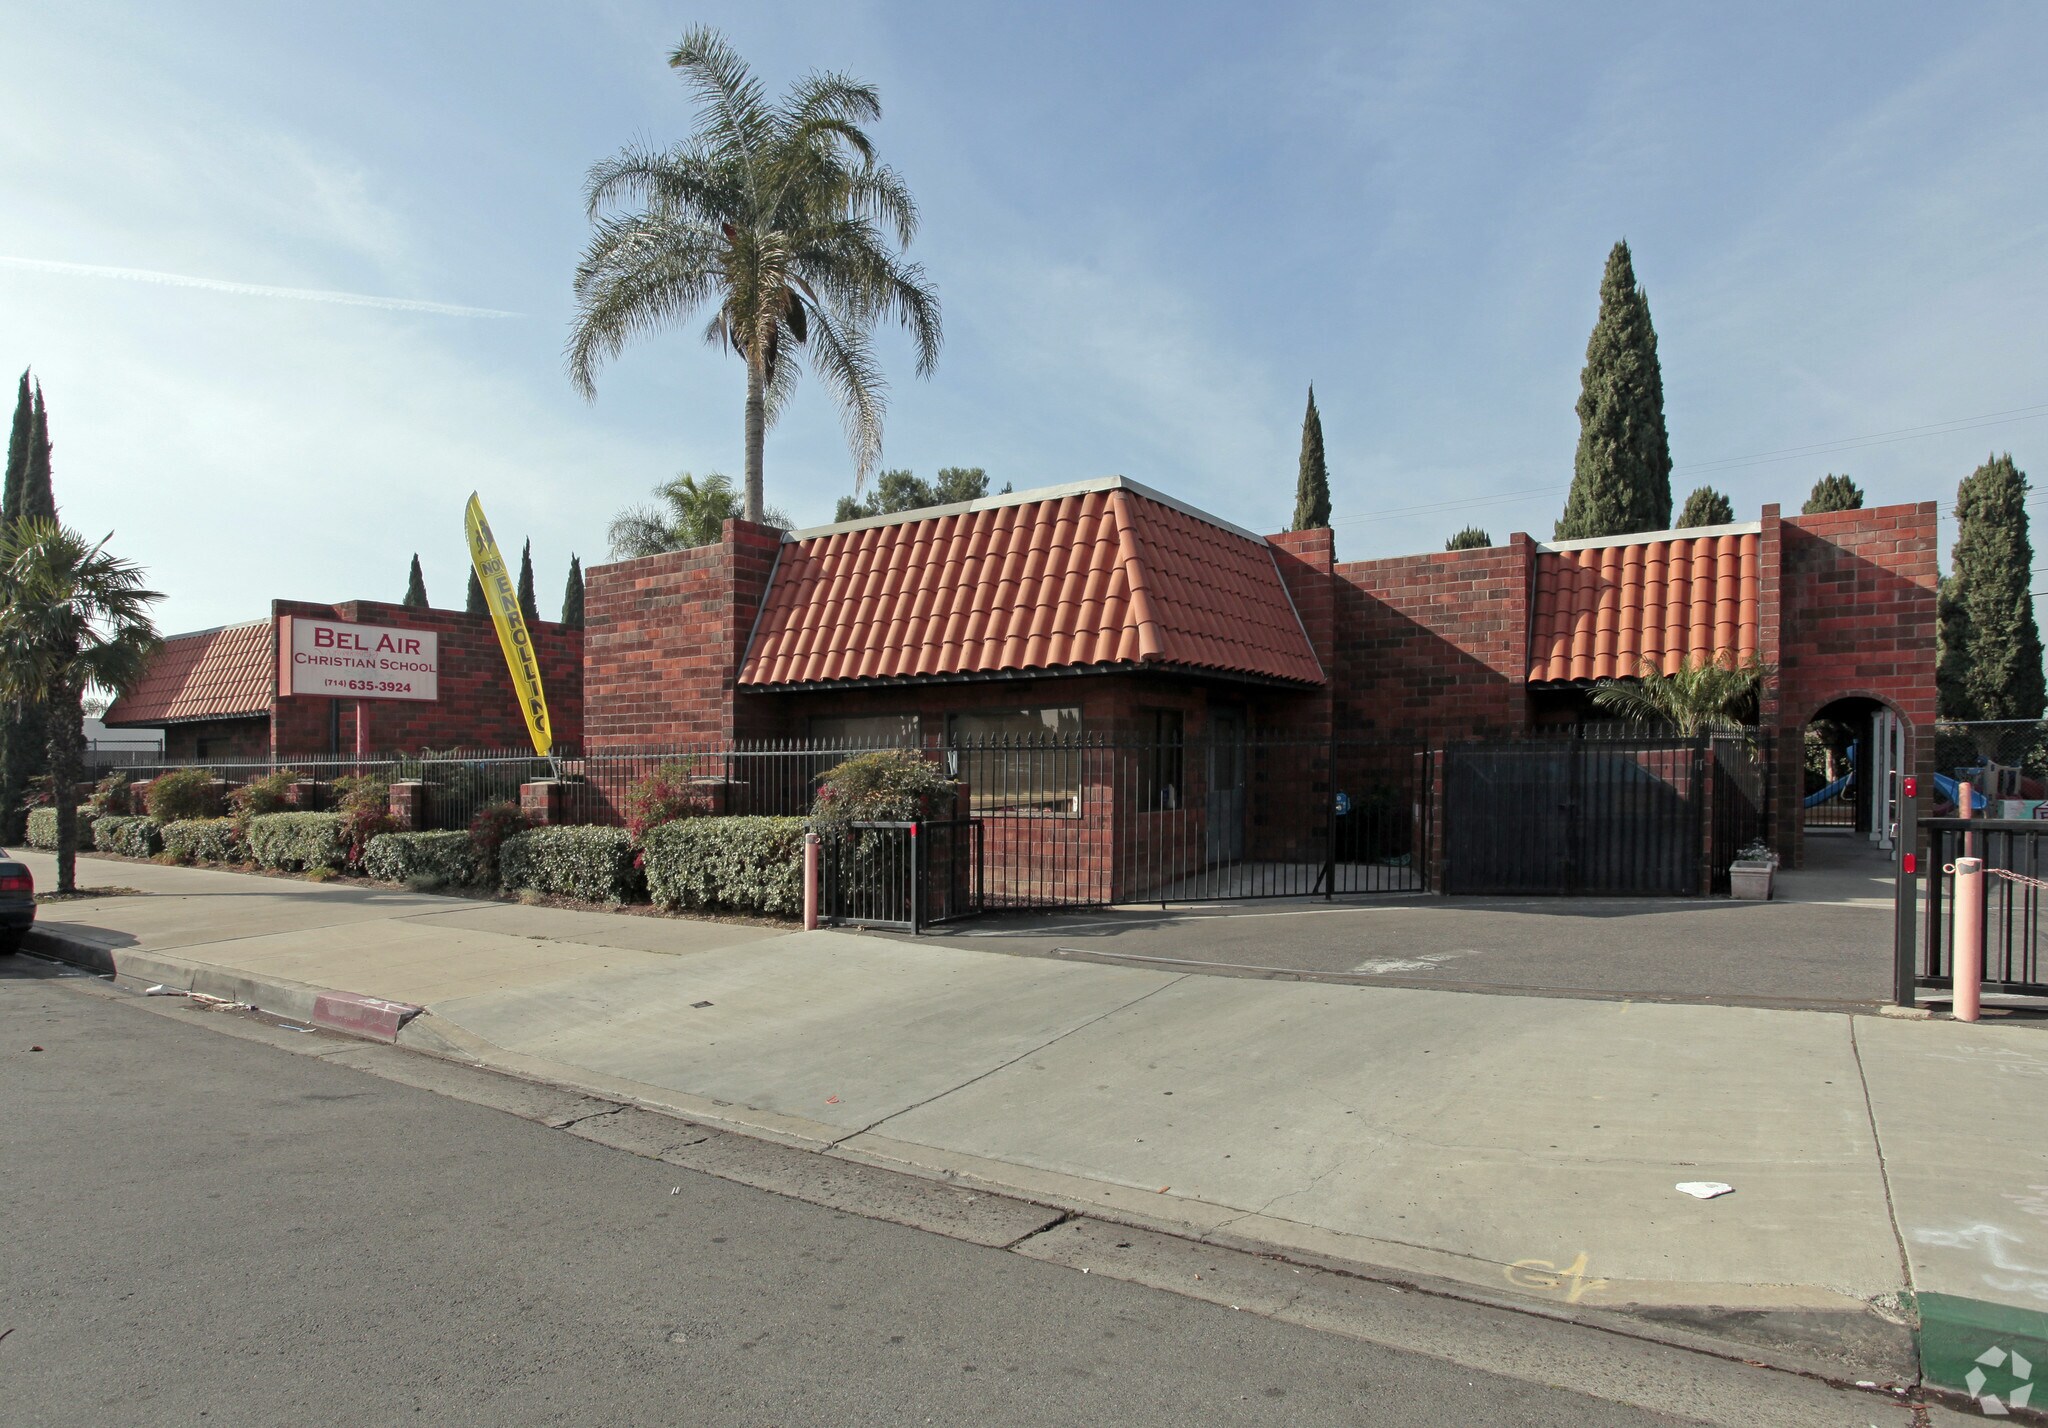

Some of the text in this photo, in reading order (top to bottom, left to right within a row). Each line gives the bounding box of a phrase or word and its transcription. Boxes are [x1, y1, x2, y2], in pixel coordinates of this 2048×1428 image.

[314, 627, 368, 652] BEL
[376, 633, 421, 655] AIR
[294, 652, 376, 669] CHRISTIAN
[380, 658, 436, 673] SCHOOL
[324, 679, 411, 693] (714) 635-3924
